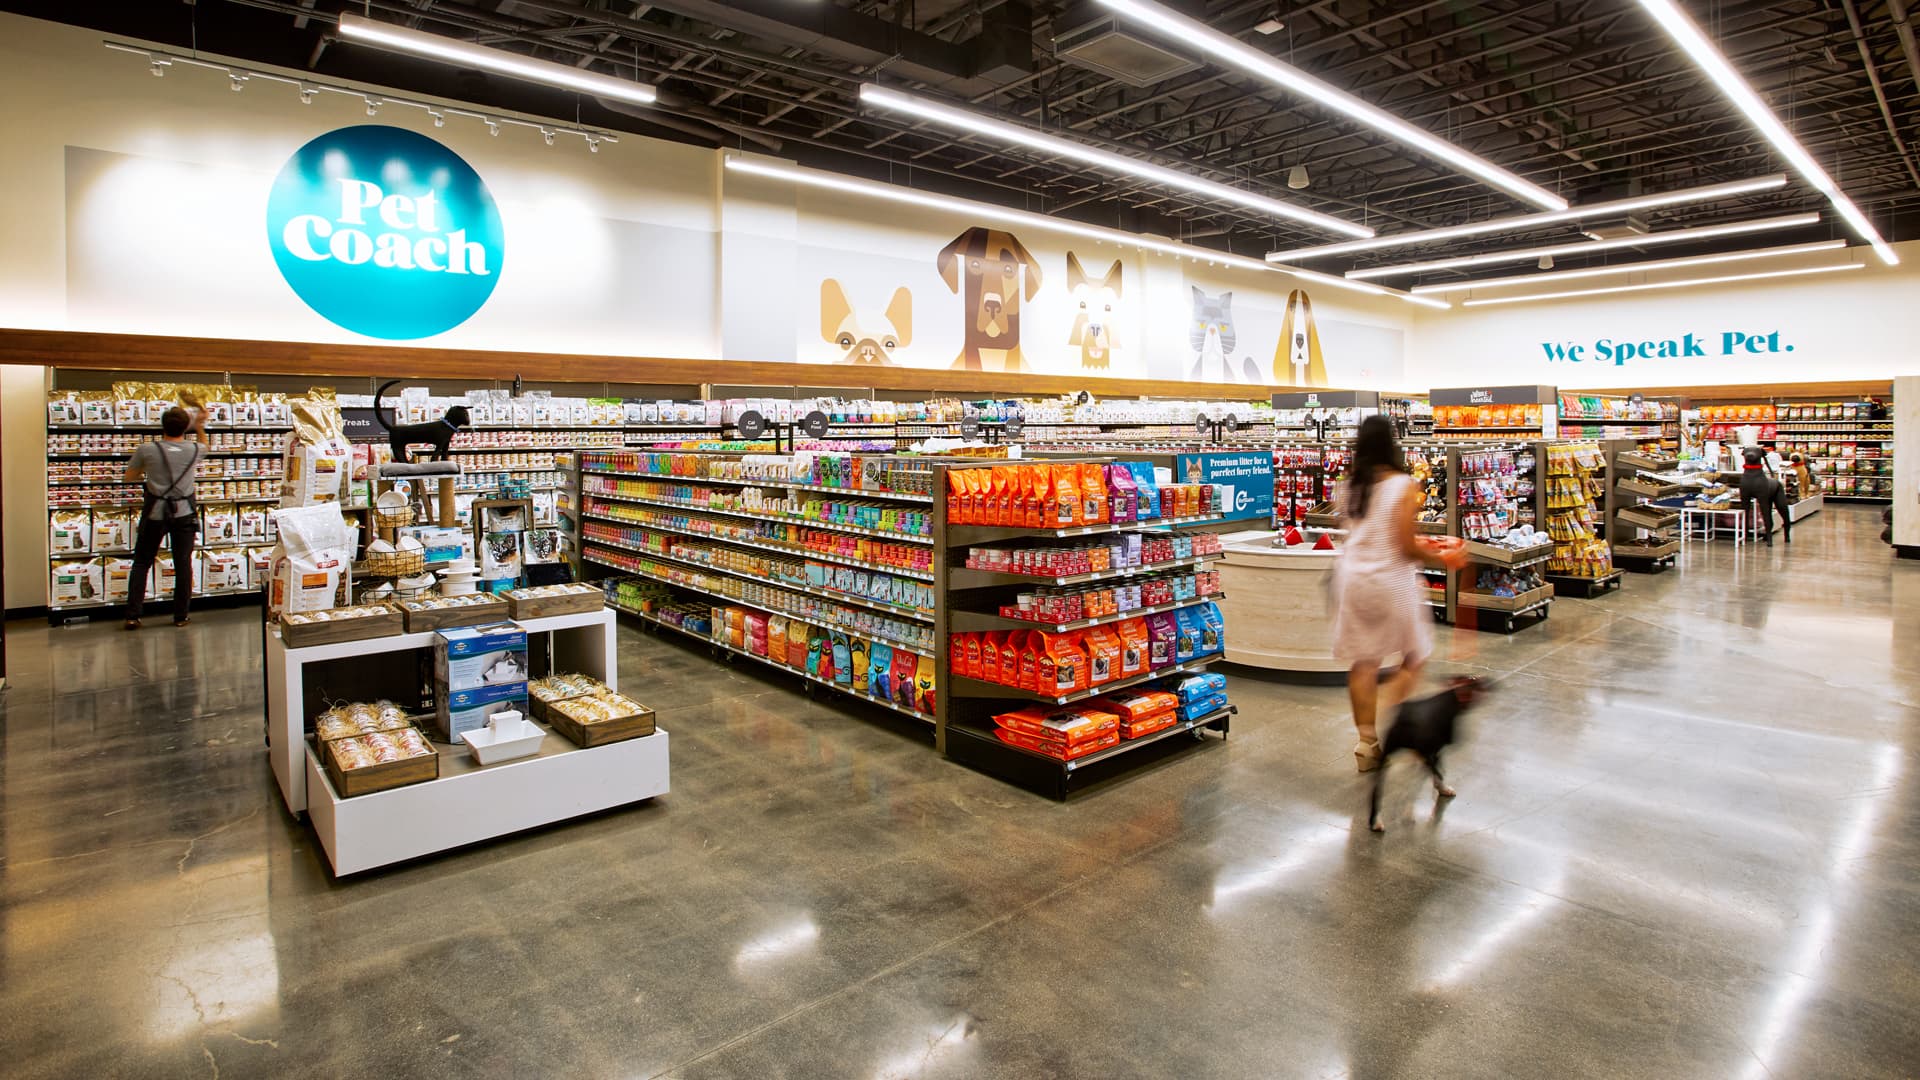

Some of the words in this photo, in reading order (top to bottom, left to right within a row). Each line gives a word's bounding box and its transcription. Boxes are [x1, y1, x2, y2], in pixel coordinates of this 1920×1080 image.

[336, 178, 440, 232] Pet
[283, 214, 491, 276] Coach
[1541, 341, 1585, 362] We
[1594, 332, 1708, 366] Speak
[1720, 330, 1795, 356] Pet.
[1210, 457, 1239, 467] Premium
[1239, 456, 1253, 465] litter
[1253, 456, 1262, 464] for
[1210, 468, 1235, 479] purrfect
[1236, 467, 1251, 477] furry
[1252, 465, 1271, 474] friend.
